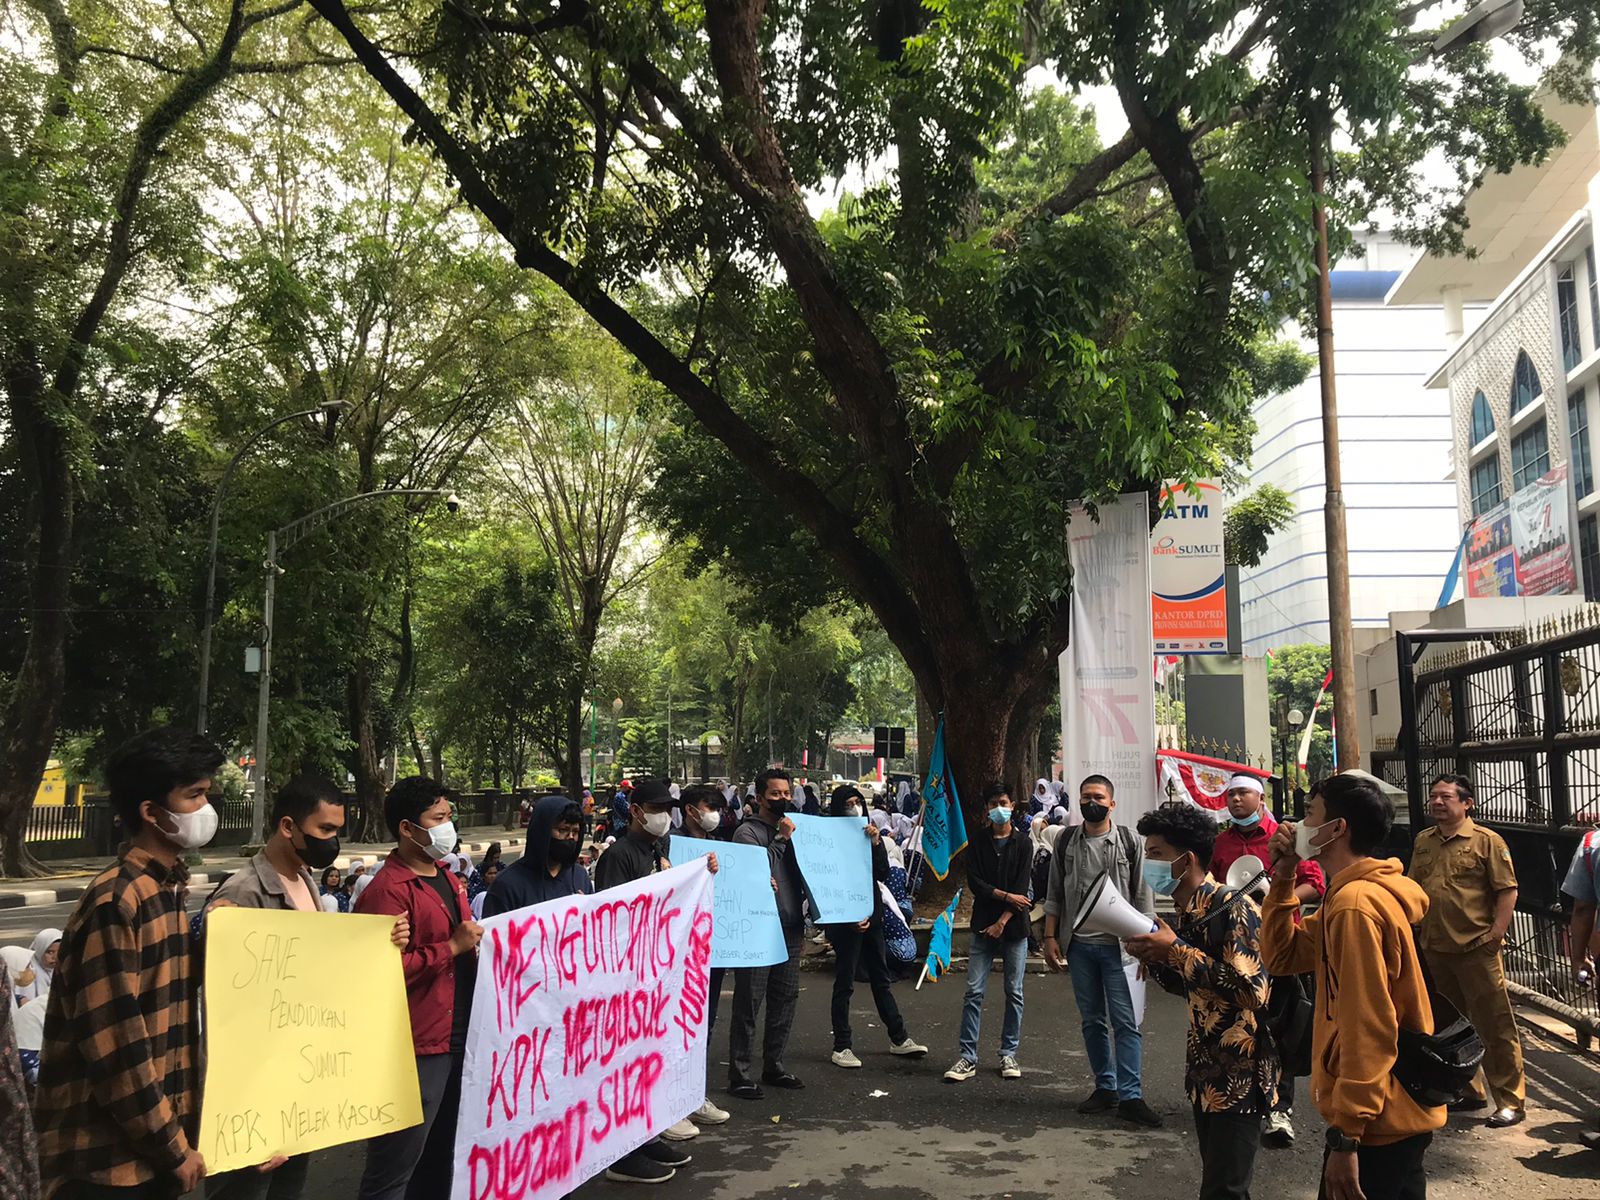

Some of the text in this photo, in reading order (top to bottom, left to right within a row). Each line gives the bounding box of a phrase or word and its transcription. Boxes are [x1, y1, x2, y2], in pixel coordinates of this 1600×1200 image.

[1163, 505, 1208, 519] ATM
[1154, 609, 1224, 620] KANTOR DPRD
[232, 931, 301, 989] SAVE
[491, 887, 681, 1034] MENGUNDANG
[268, 988, 346, 1033] PENDIDIKAN
[485, 1026, 552, 1129] KPK
[213, 1108, 267, 1165] KPK
[279, 1101, 330, 1145] MELEK
